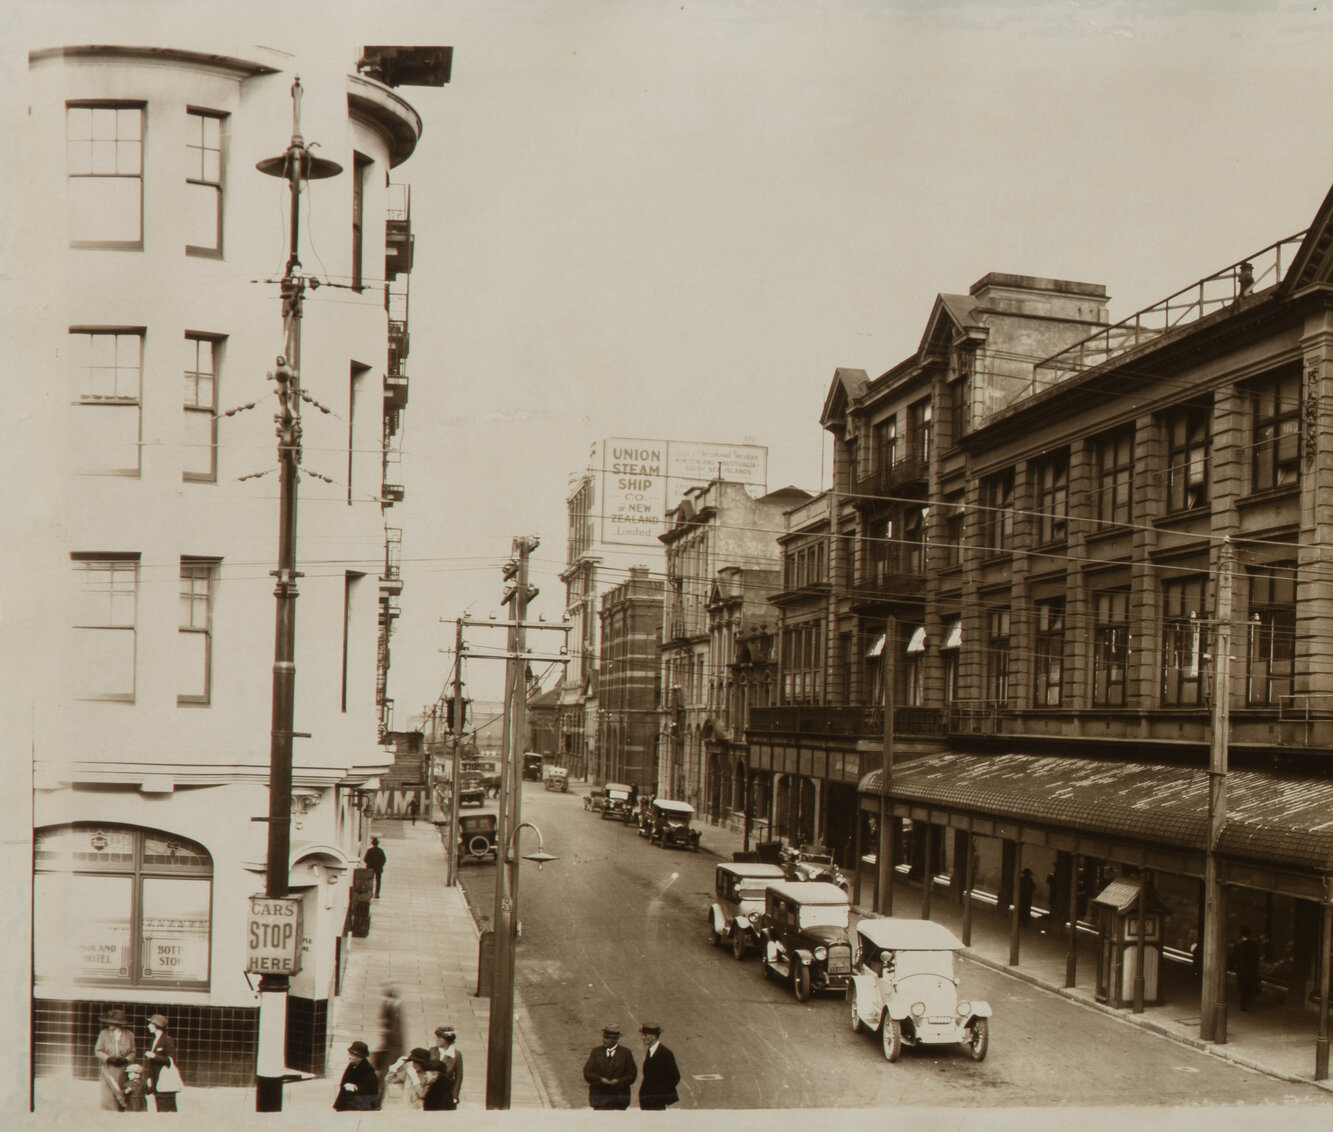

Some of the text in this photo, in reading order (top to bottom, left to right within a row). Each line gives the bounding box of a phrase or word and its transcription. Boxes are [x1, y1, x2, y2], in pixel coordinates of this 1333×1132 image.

[612, 447, 661, 462] UNION
[612, 463, 660, 477] STEAM
[618, 478, 652, 491] SHIP
[628, 503, 652, 513] NEW
[611, 514, 659, 525] ZEALAND
[251, 903, 295, 917] CARS
[249, 921, 293, 950] STOP
[249, 957, 292, 971] HERE
